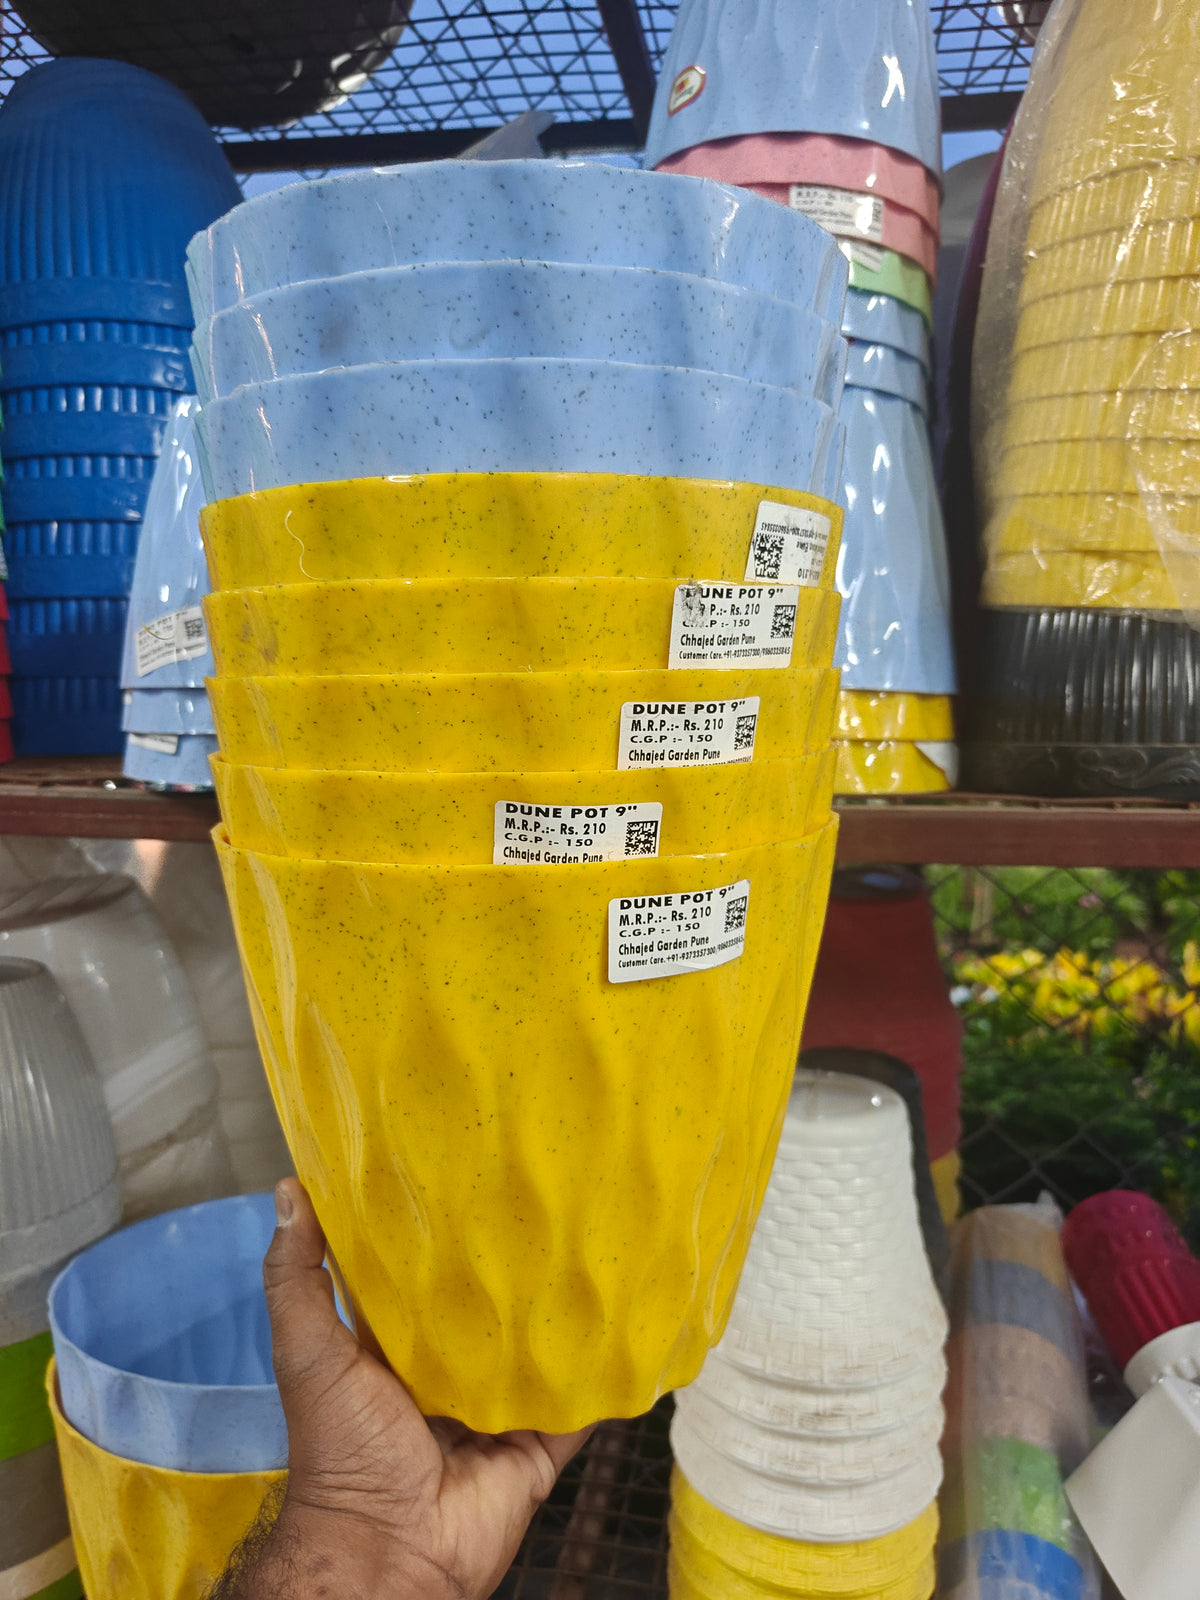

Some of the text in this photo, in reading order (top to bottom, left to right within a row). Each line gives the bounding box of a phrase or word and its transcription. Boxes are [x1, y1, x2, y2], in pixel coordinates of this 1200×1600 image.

[739, 588, 764, 599] POT
[767, 588, 784, 599] 9"
[730, 603, 741, 616] Rs.
[744, 603, 760, 615] 210
[733, 619, 750, 628] 150
[680, 633, 756, 649] Chhajed Garden Pune
[679, 650, 708, 660] Customer
[632, 700, 746, 715] DUNE POT 9"
[630, 718, 724, 732] M.R.P.:- Rs. 210
[630, 735, 668, 743] C.G.P
[688, 734, 713, 743] 150
[628, 749, 665, 764] Chhajed
[668, 749, 700, 761] Garden
[702, 748, 721, 760] Pune
[505, 803, 638, 819] DUNE POT 9"
[504, 817, 606, 835] M.R.P.:- Rs. 210
[504, 832, 543, 844] C.G.P
[566, 838, 593, 847] 150
[503, 846, 604, 864] Chhajed Garden Pune
[620, 886, 735, 910] DUNE POT 9"
[619, 906, 711, 926] M.R.P.:- Rs. 210
[619, 927, 656, 937] C.G.P
[676, 922, 700, 932] 150
[618, 936, 709, 956] Chhajed Garden Pune
[618, 957, 648, 968] Customer
